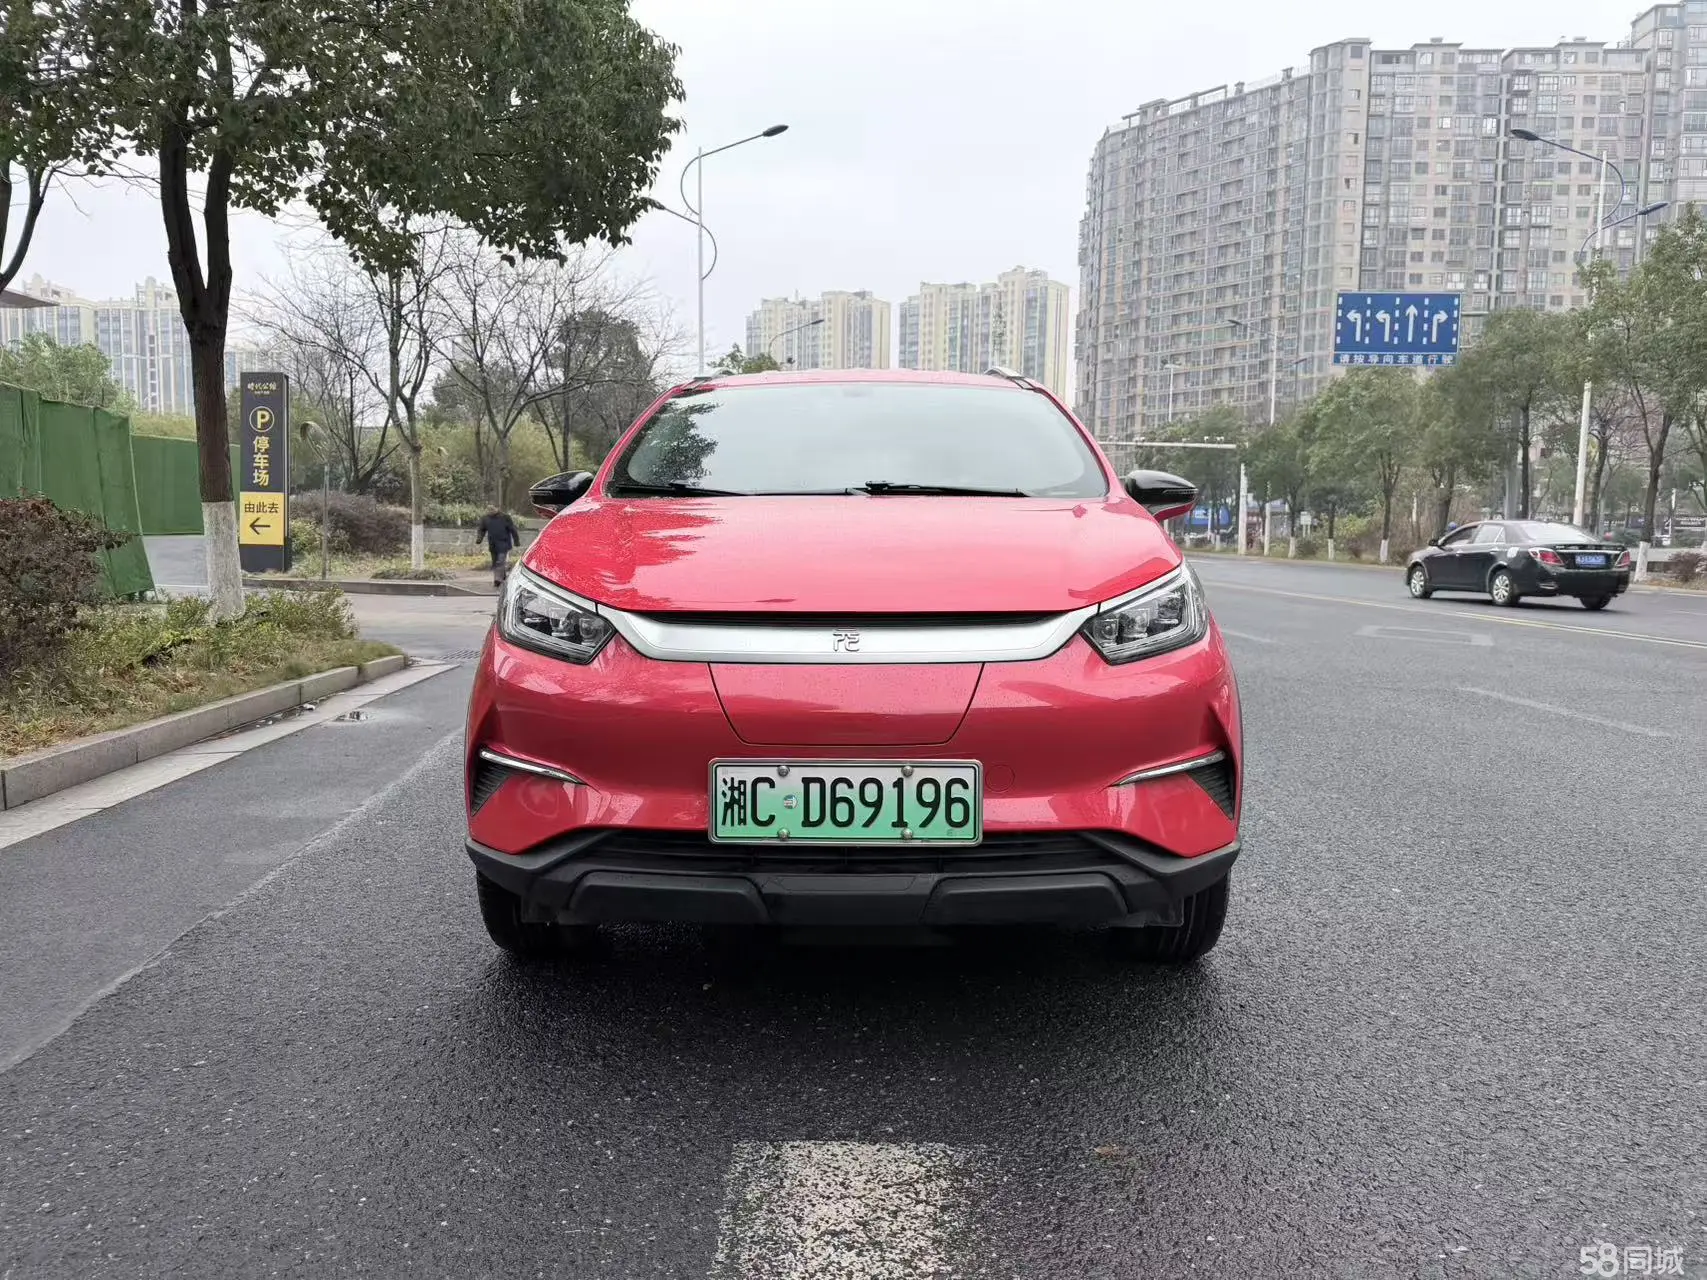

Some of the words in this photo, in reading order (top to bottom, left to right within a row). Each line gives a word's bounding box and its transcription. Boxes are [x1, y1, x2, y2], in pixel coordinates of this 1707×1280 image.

[256, 410, 270, 429] P
[253, 436, 270, 487] 停车场
[244, 502, 279, 514] 由此去
